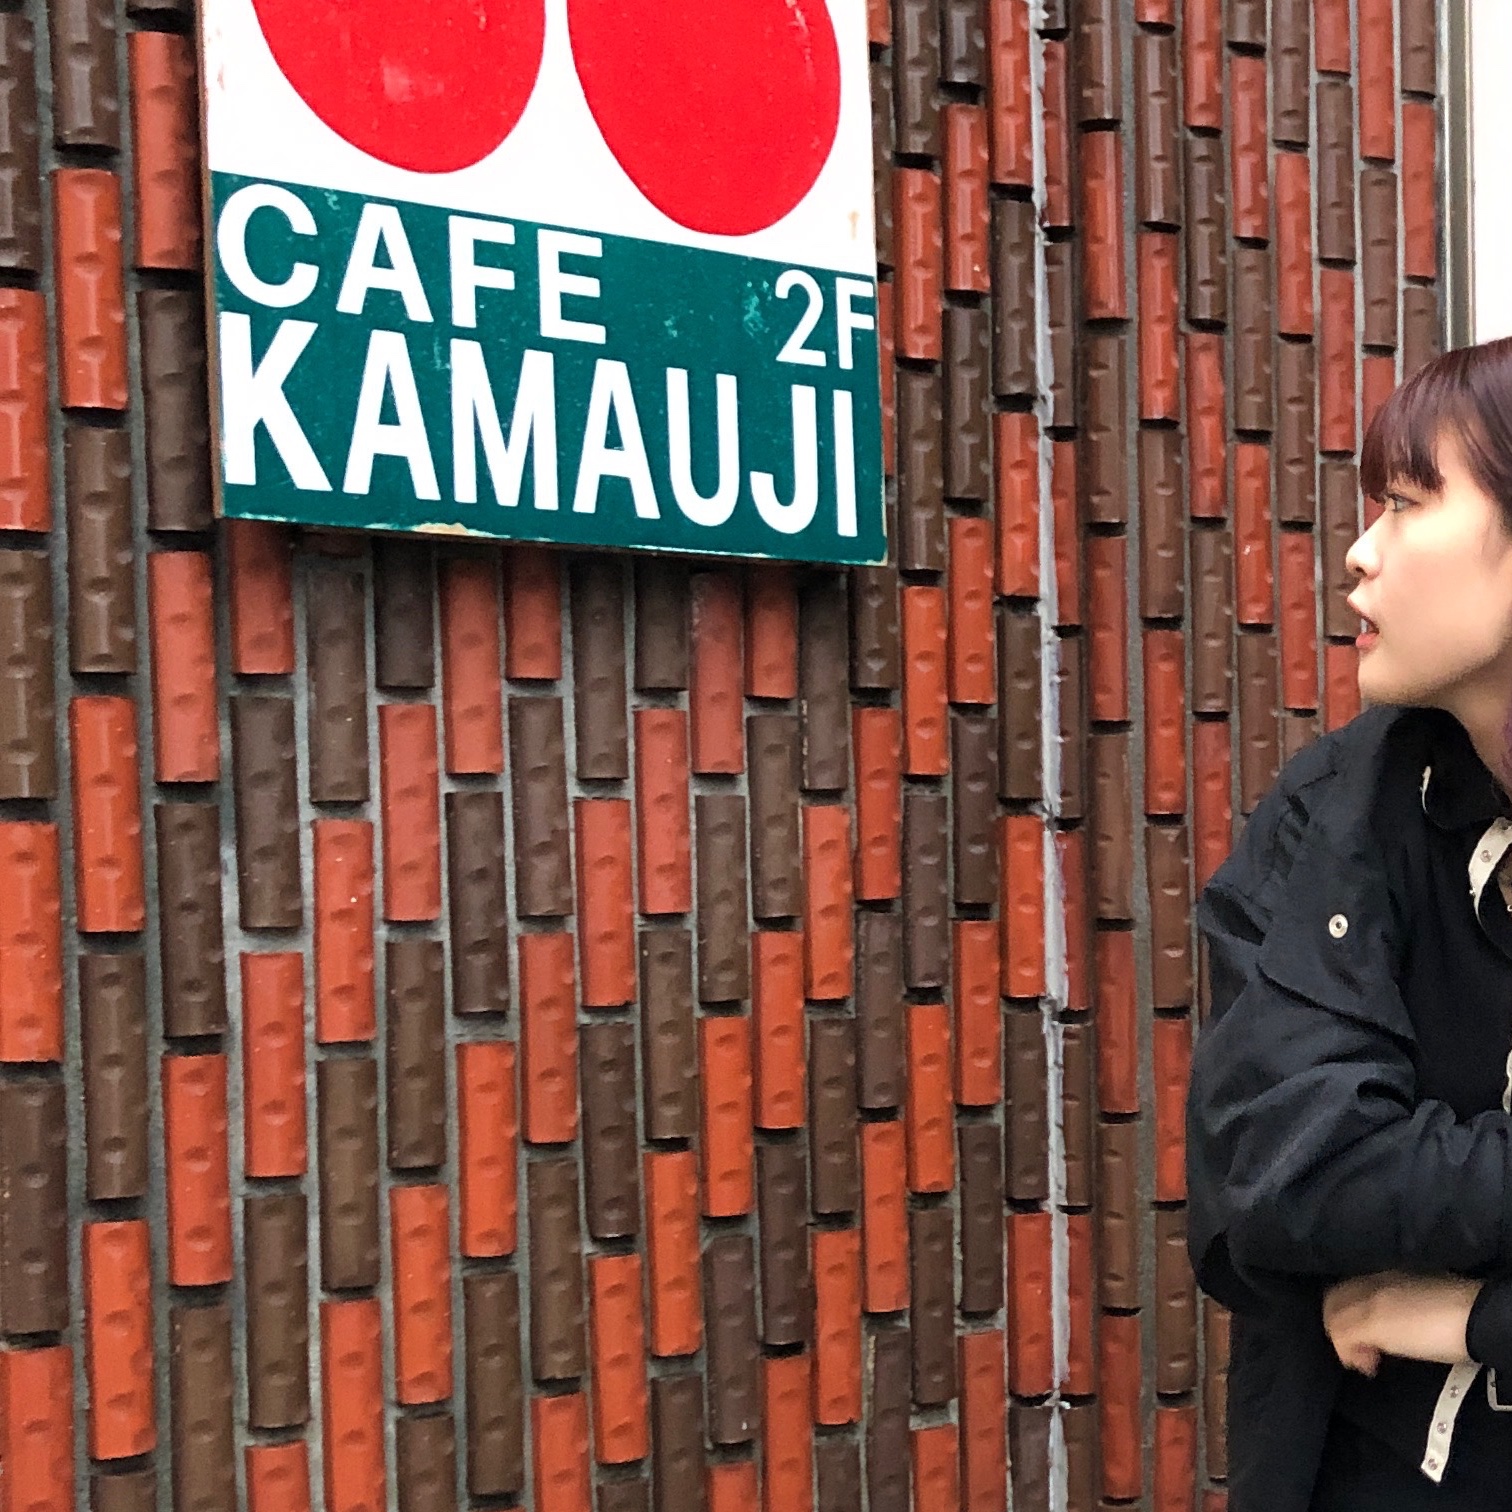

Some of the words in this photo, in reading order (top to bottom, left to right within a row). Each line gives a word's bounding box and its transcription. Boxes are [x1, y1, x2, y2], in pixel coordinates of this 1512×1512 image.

[216, 183, 607, 345] CAFE
[774, 268, 876, 371] 2F
[219, 310, 859, 537] KAMAUJI
